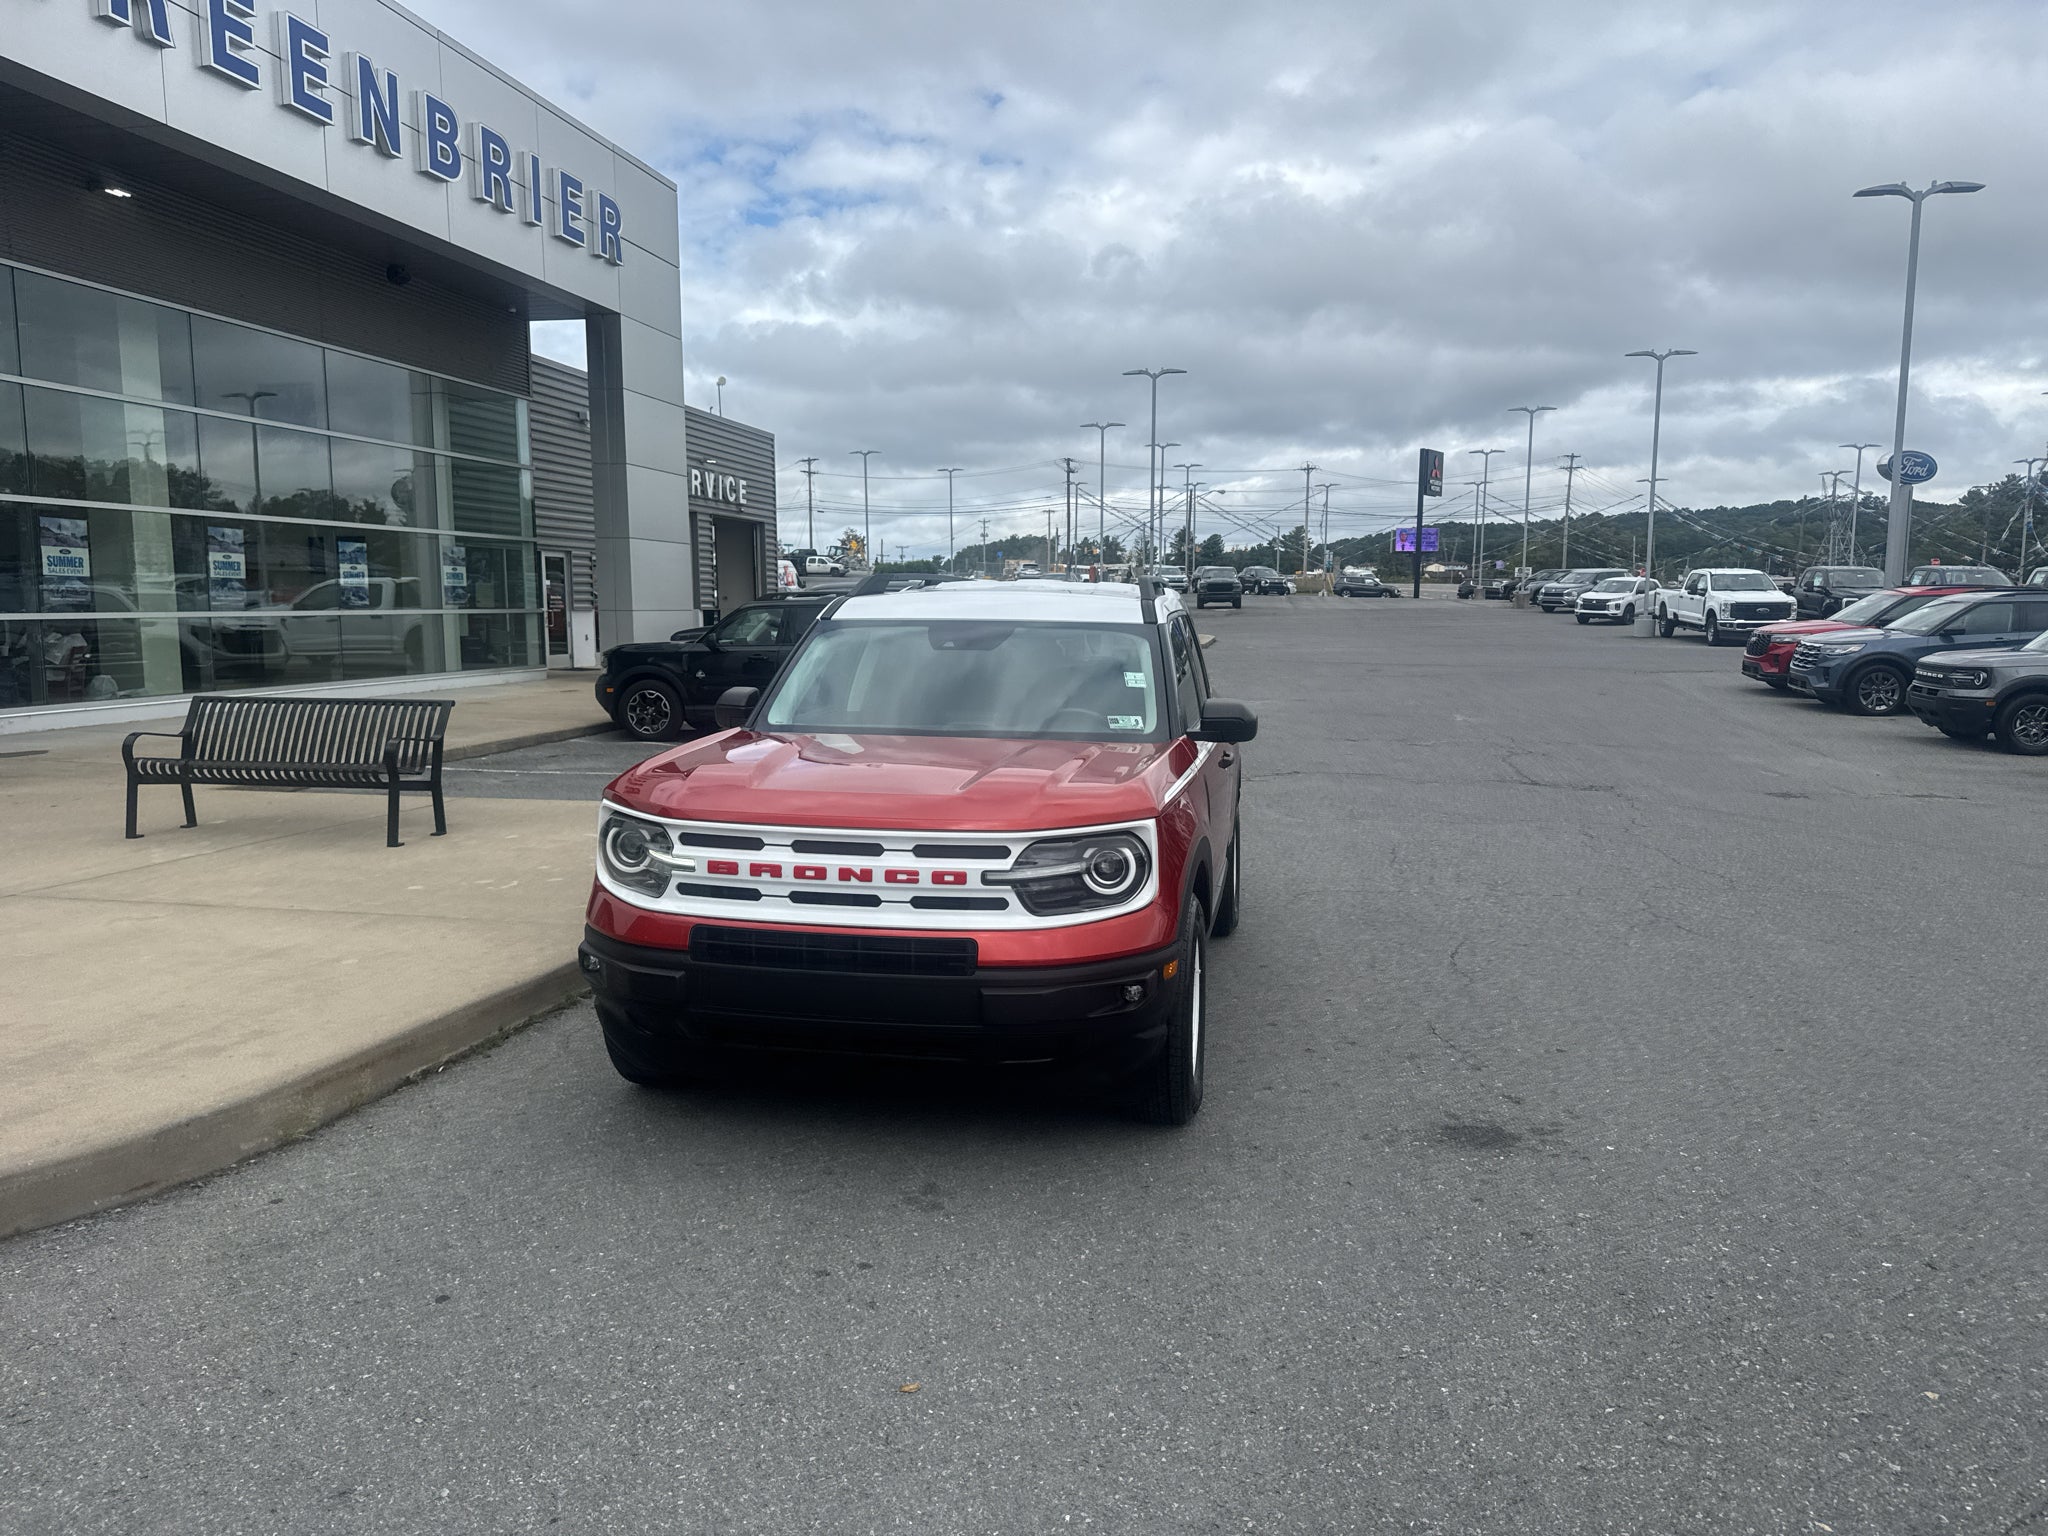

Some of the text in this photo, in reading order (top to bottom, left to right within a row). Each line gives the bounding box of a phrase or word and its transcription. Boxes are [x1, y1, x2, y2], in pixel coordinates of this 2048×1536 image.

[1900, 456, 1929, 477] Ford
[691, 468, 747, 504] RVICE
[46, 554, 84, 569] SUMMER
[212, 560, 241, 572] SUMMER
[707, 859, 968, 886] BRONCO
